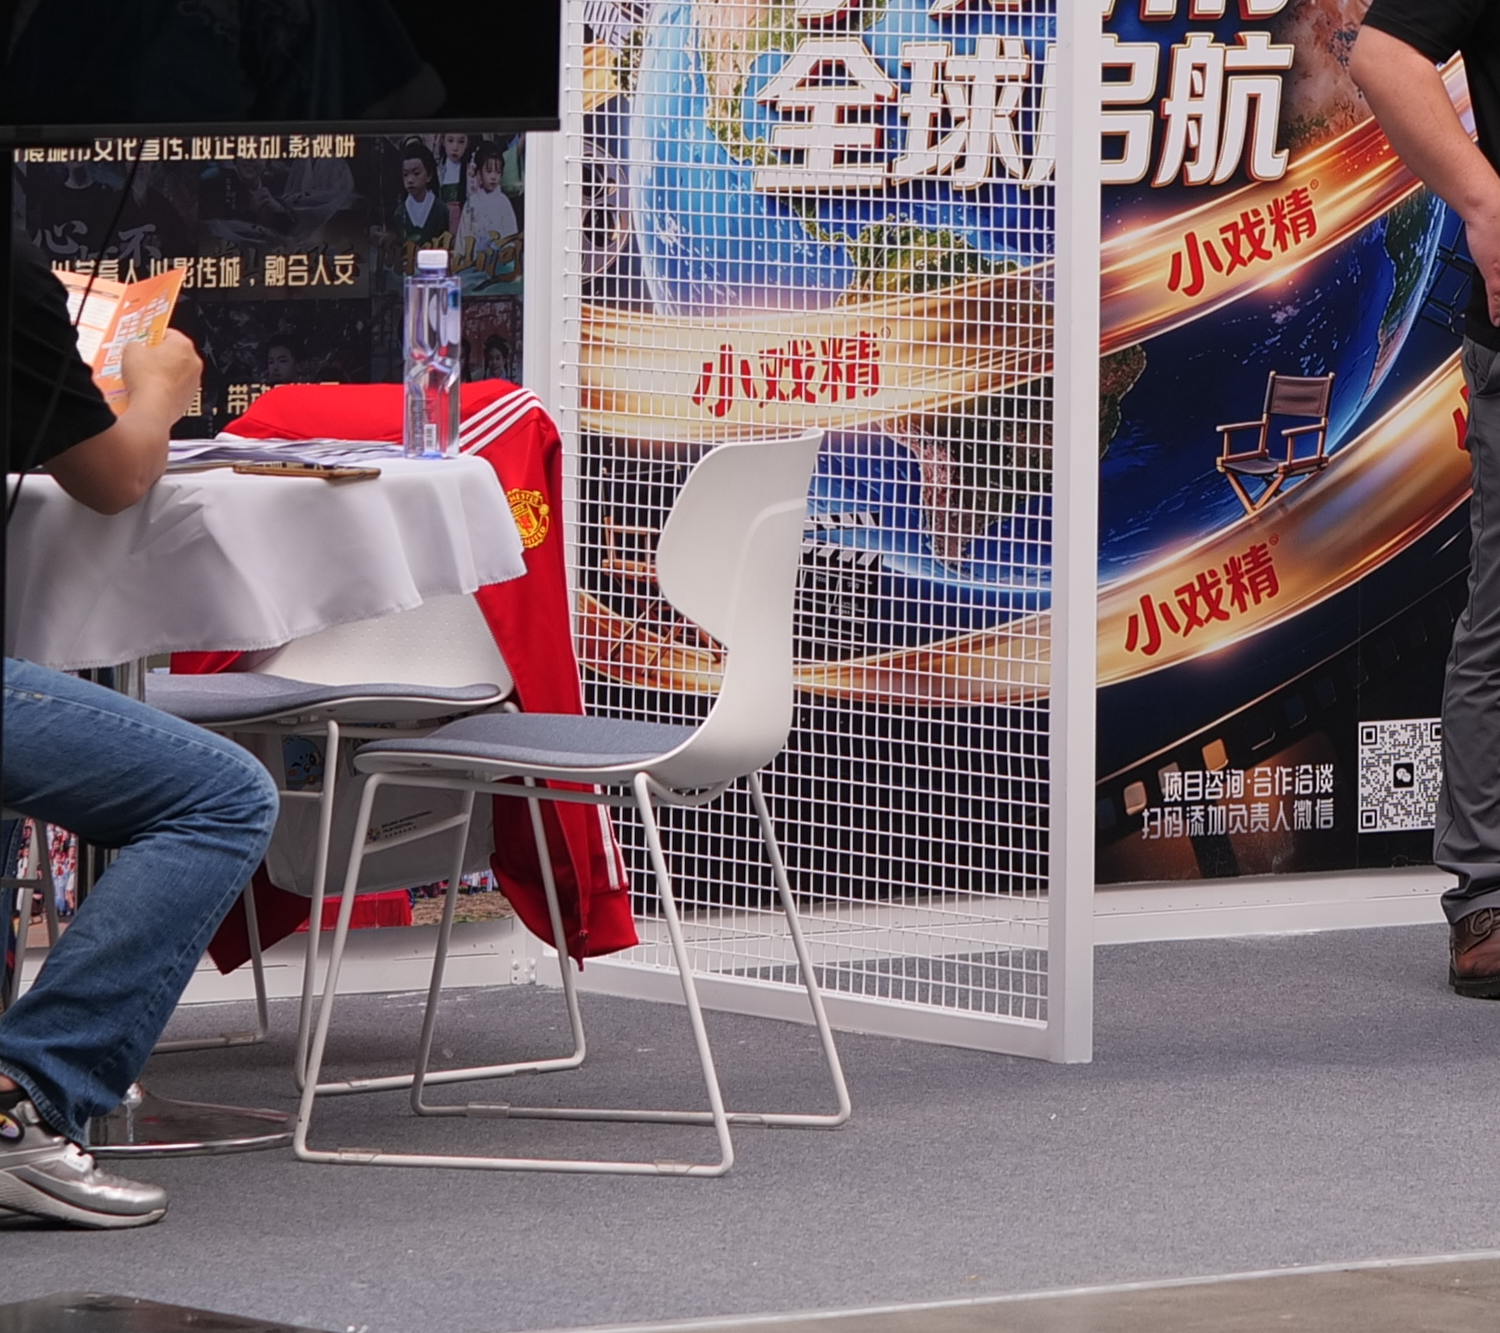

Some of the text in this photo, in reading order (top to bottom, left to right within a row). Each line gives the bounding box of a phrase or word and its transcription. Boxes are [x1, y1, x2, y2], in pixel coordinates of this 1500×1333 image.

[1167, 185, 1320, 300] 小戏精
[692, 333, 884, 419] 小戏精
[1123, 541, 1281, 658] 小戏精
[1141, 798, 1334, 840] 扫码添加负责人微信
